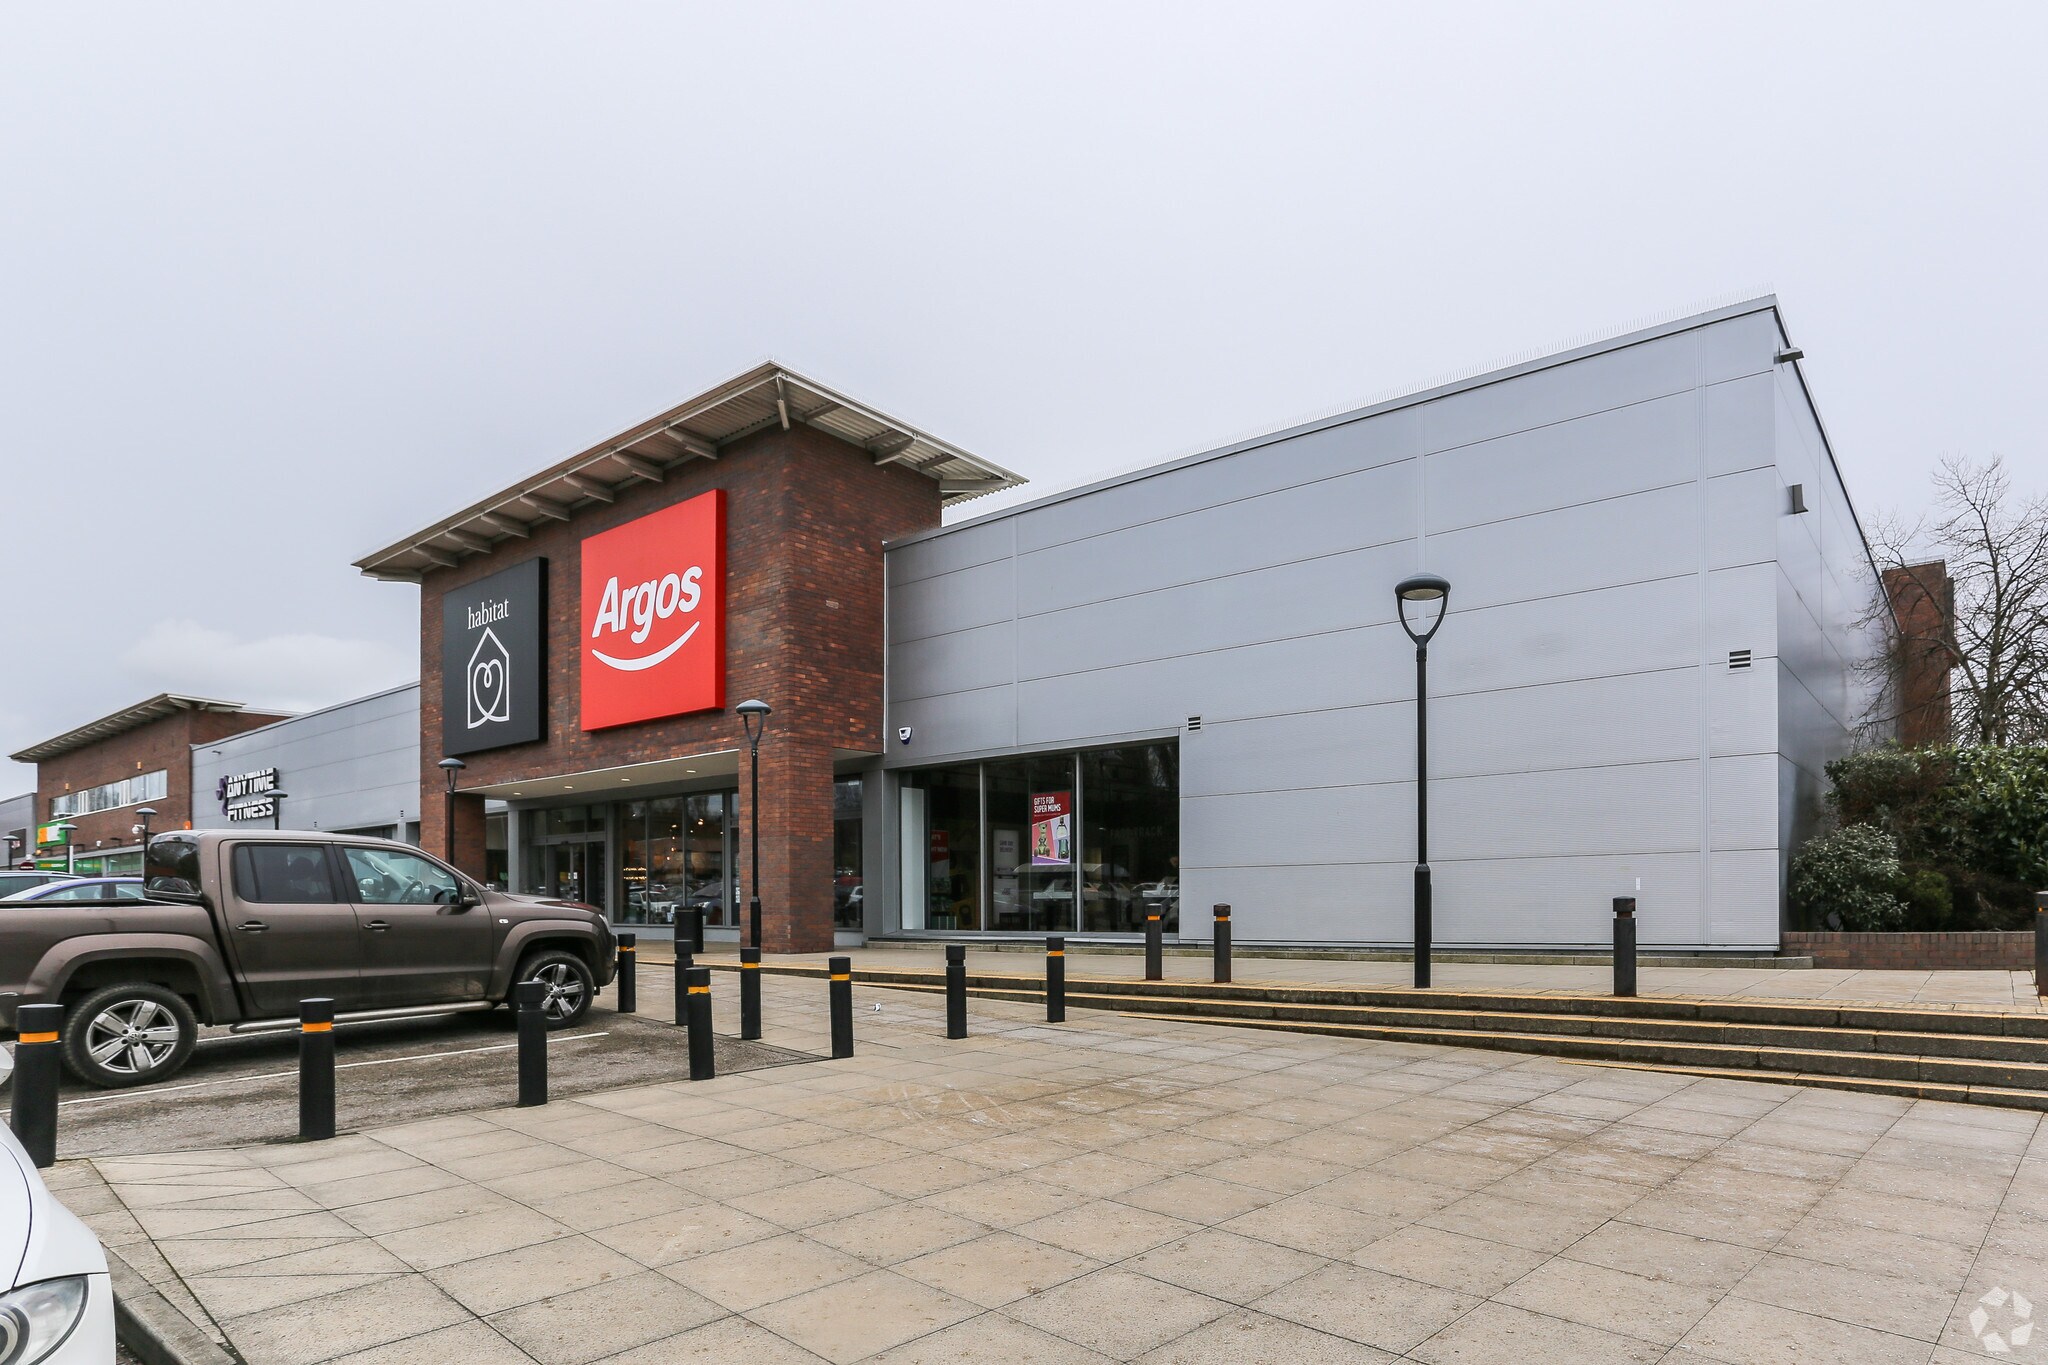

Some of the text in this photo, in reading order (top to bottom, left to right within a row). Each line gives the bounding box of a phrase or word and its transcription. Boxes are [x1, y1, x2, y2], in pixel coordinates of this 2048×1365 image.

[468, 598, 510, 629] habitat
[592, 566, 702, 644] Argos
[227, 768, 274, 798] ANYTIME
[228, 797, 274, 822] FITNESS
[1034, 796, 1055, 806] GIFTS FOR
[1034, 804, 1062, 814] SUPER MUMS
